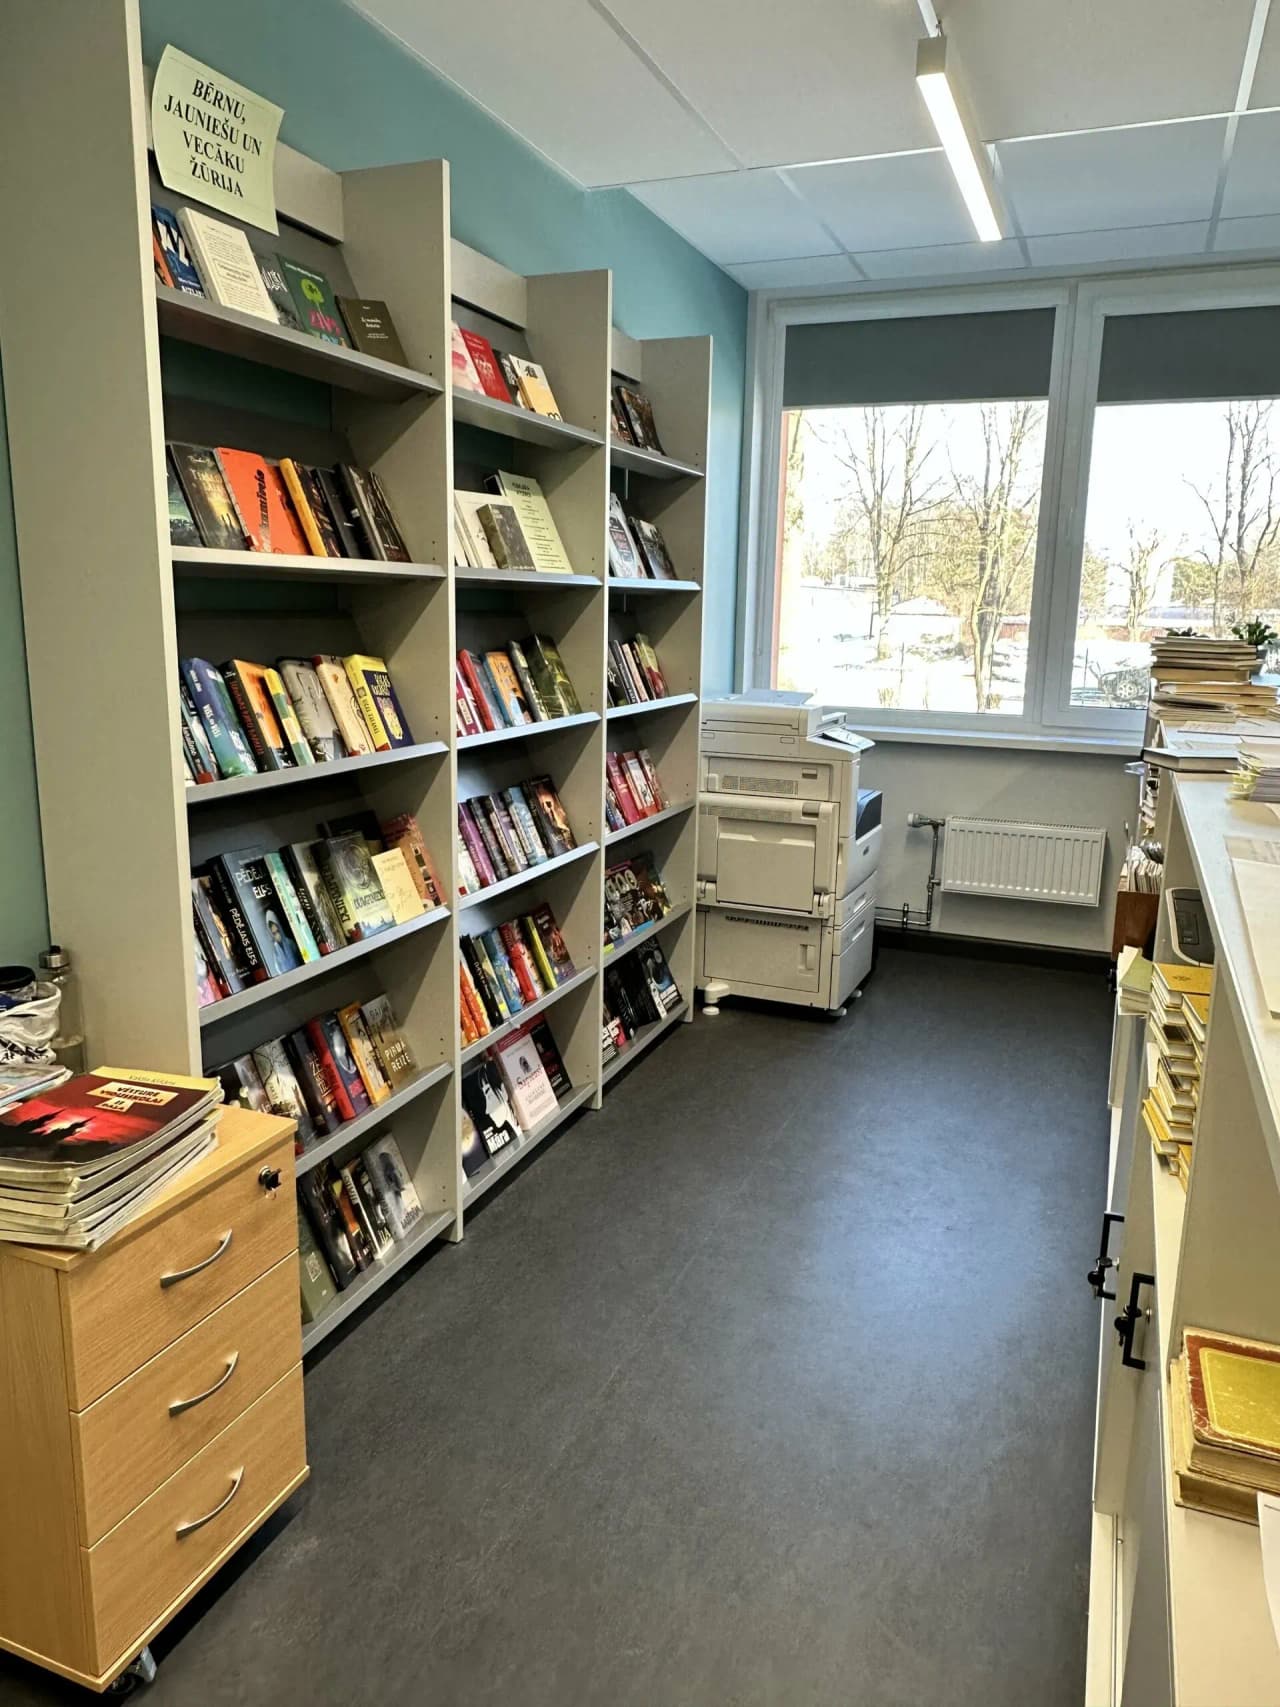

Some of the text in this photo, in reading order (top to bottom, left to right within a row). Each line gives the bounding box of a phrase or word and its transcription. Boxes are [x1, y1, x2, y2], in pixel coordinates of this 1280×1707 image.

[192, 79, 246, 125] BĒRNU,
[164, 95, 262, 157] JAUNIEŠU UN
[183, 130, 245, 174] VECĀKU
[190, 155, 244, 198] ŽŪRIJA
[229, 908, 258, 966] PĒDĒJAIS ELFS
[391, 1052, 411, 1073] REIZE
[117, 1086, 161, 1098] VĒSTURE
